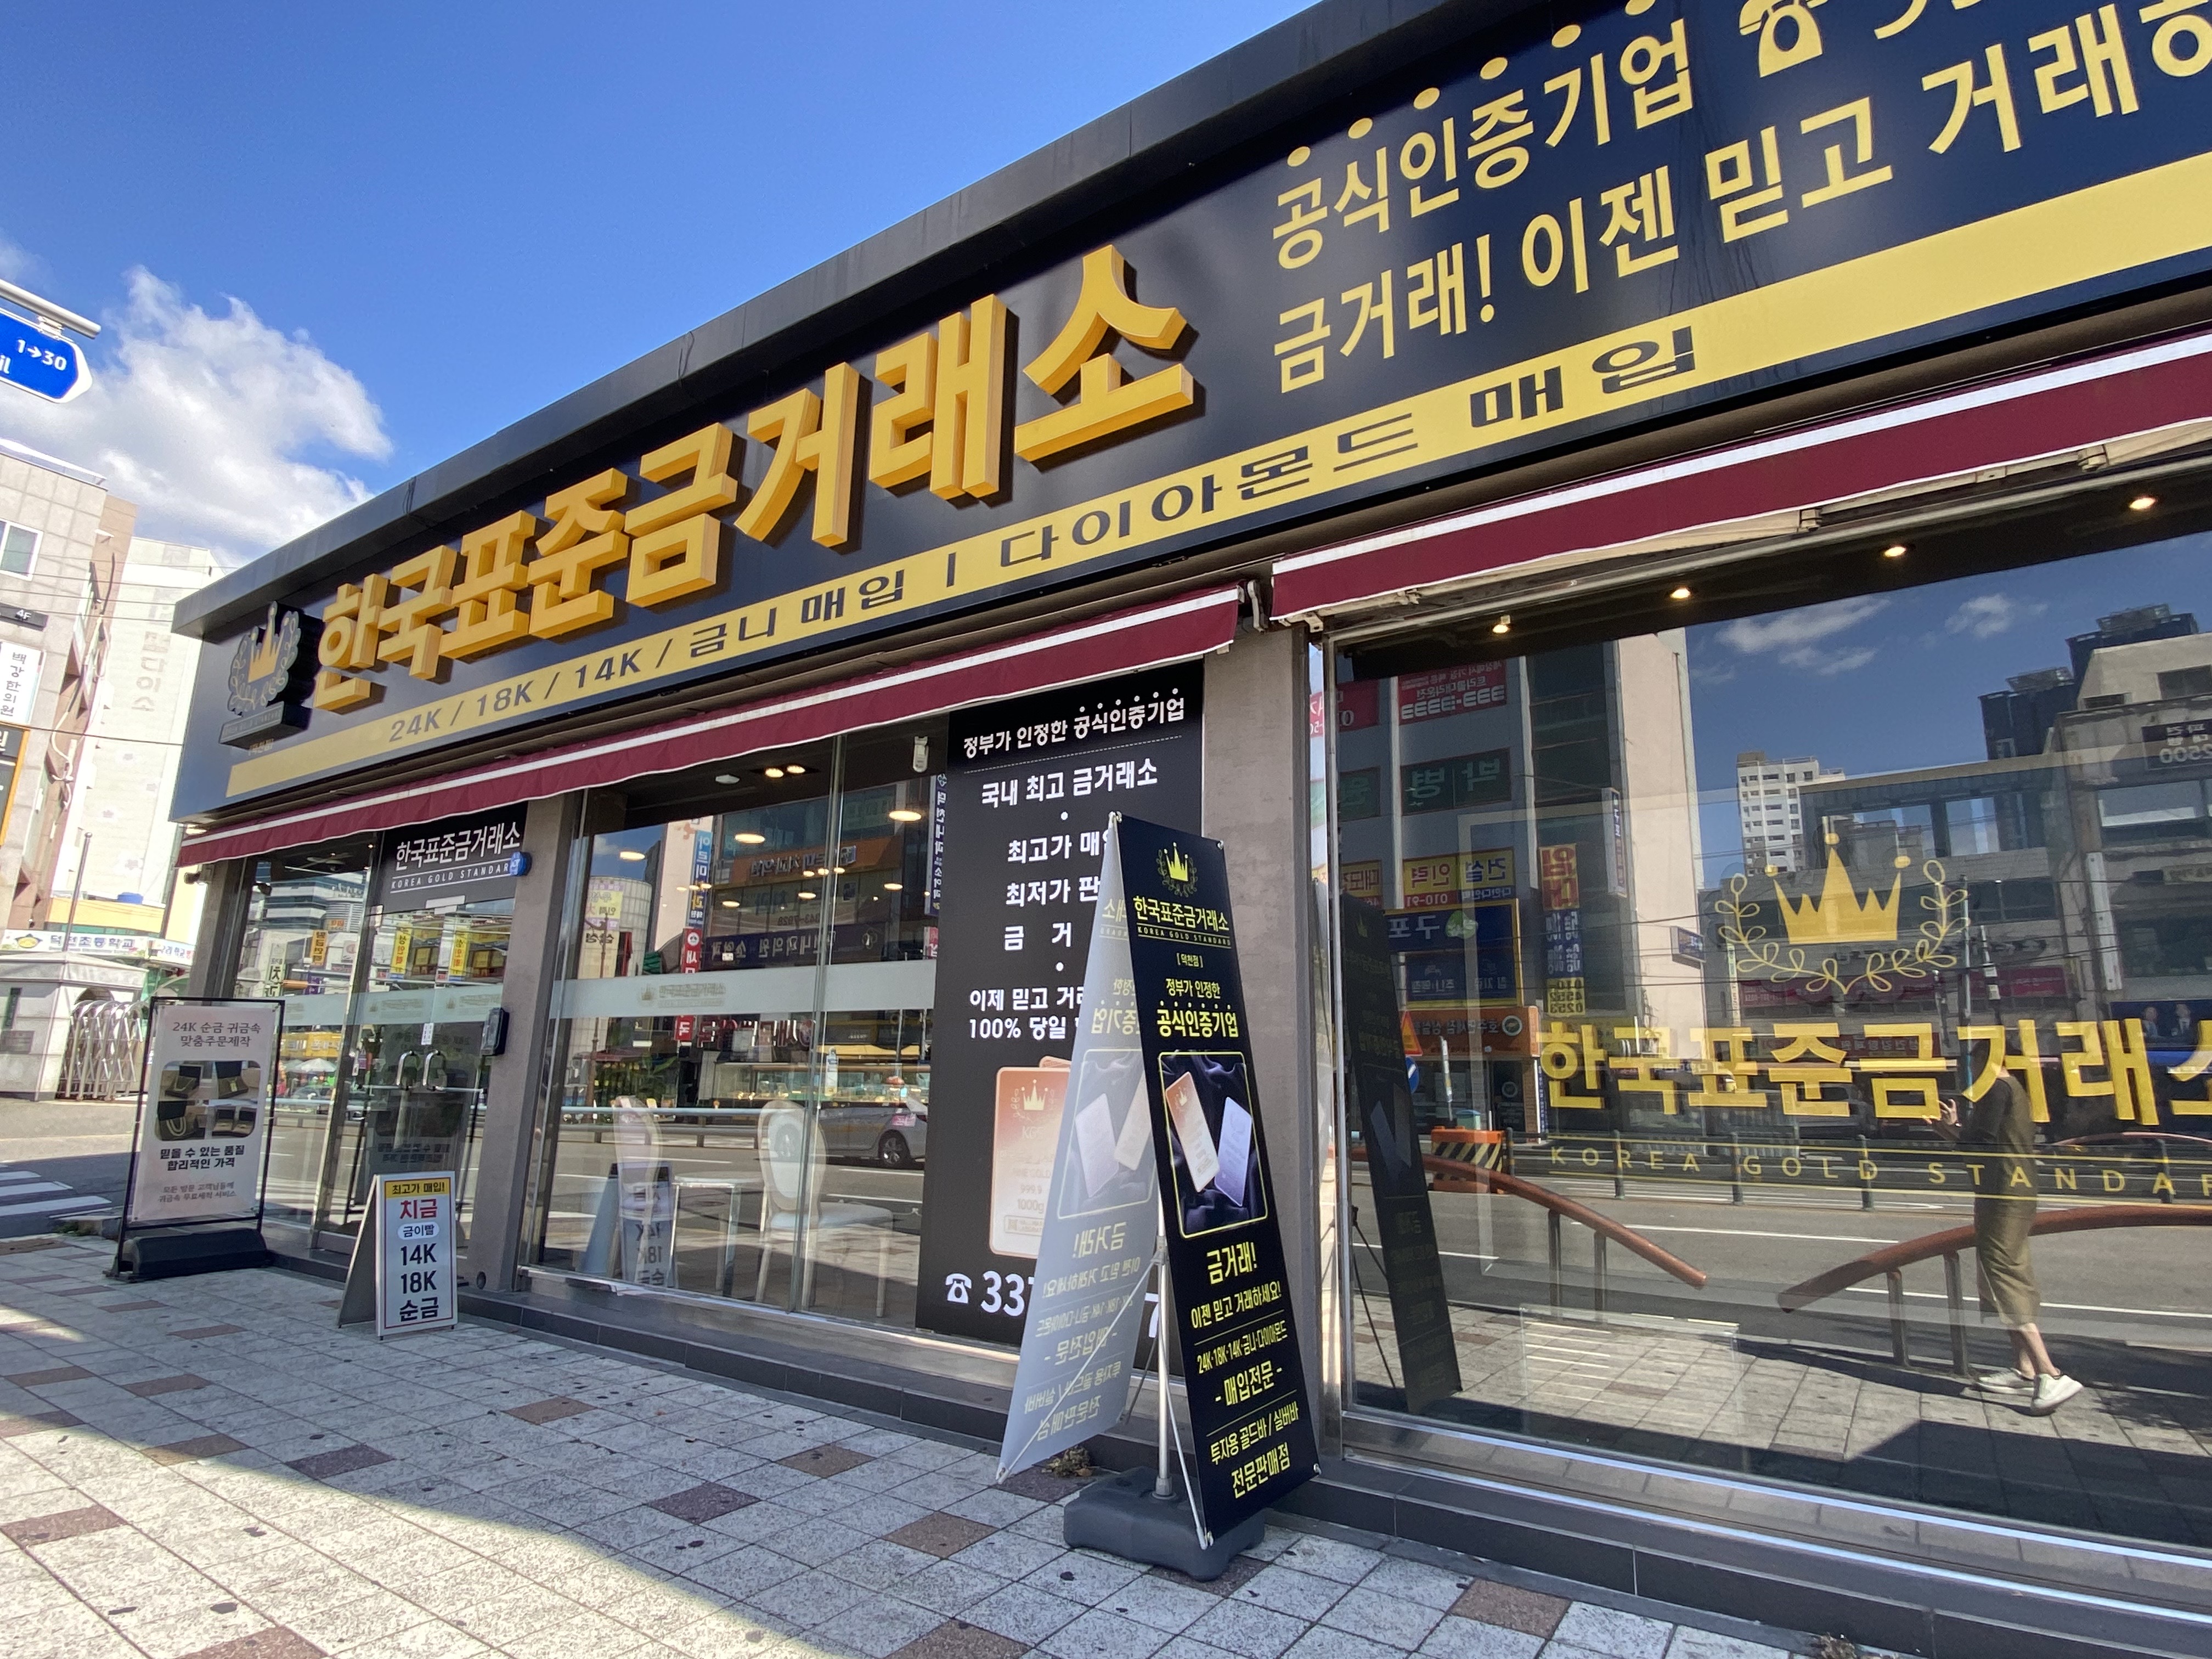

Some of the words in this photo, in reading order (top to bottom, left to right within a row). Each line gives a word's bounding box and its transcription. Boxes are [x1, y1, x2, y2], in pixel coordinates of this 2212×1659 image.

[1272, 18, 1694, 269] 공식인증기업
[1274, 234, 1493, 393] 금거래!
[1522, 166, 1679, 294] 이젠
[1706, 97, 1893, 243] 믿고
[314, 244, 1193, 710] 한국표준금거래소
[390, 708, 439, 742] 24K
[477, 681, 532, 716] 18K
[575, 649, 639, 689] 14K
[690, 608, 776, 658] 금니
[800, 569, 904, 625] 매입
[1001, 413, 1418, 567] 다이아몬드
[16, 609, 31, 620] 4F
[964, 731, 1011, 759] 정부가
[1017, 720, 1068, 749] 인정한
[1074, 697, 1185, 739] 공식인증기업
[982, 779, 1018, 808] 국내
[1026, 772, 1064, 802] 최고
[1073, 758, 1158, 796] 금거래소
[396, 821, 521, 871] 한국표준금거래소
[1008, 835, 1072, 864] 최고가
[391, 877, 421, 889] KOREA
[428, 873, 453, 884] GOLD
[460, 862, 509, 878] STANDAR
[1006, 878, 1070, 907] 최저가
[1079, 876, 1101, 902] 판
[1133, 895, 1229, 932] 한국표준금거래소
[1137, 926, 1165, 936] KOREA
[1170, 930, 1189, 940] GOLD
[1193, 934, 1231, 946] STANDARD
[969, 989, 1005, 1012] 이제
[1013, 988, 1048, 1011] 믿고
[1166, 978, 1193, 997] 정부가
[1195, 980, 1221, 999] 인정한
[172, 1022, 196, 1032] 24K
[201, 1023, 224, 1034] 순금
[227, 1022, 262, 1034] 귀금속
[969, 1018, 1022, 1039] 100%
[1030, 1015, 1066, 1040] 당일
[1156, 1008, 1239, 1038] 공식인증기업
[160, 1147, 182, 1160] 믿을
[185, 1147, 196, 1158] 수
[200, 1146, 221, 1157] 있는
[224, 1144, 245, 1156] 품질
[167, 1159, 211, 1171] 합리적인
[213, 1157, 235, 1169] 가격
[1550, 1146, 1701, 1172] KOREA
[1742, 1155, 1878, 1181] GOLD
[392, 1183, 420, 1195] 최고가
[424, 1181, 445, 1193] 매입!
[399, 1198, 438, 1220] 치금
[403, 1224, 435, 1238] 금이빨
[400, 1243, 438, 1266] 14K
[1206, 1241, 1257, 1285] 금거래!
[400, 1270, 438, 1294] 18K
[980, 1270, 1035, 1316] 33
[399, 1296, 439, 1323] 순금
[1190, 1303, 1212, 1329] 이젠
[1212, 1296, 1234, 1322] 믿고
[1234, 1280, 1282, 1313] 거래하세요!
[1223, 1360, 1274, 1406] 매입전문
[1210, 1431, 1239, 1465] 투자용
[1239, 1417, 1267, 1450] 골드바
[1273, 1401, 1299, 1432] 실버바
[1231, 1441, 1290, 1499] 전문판매점
